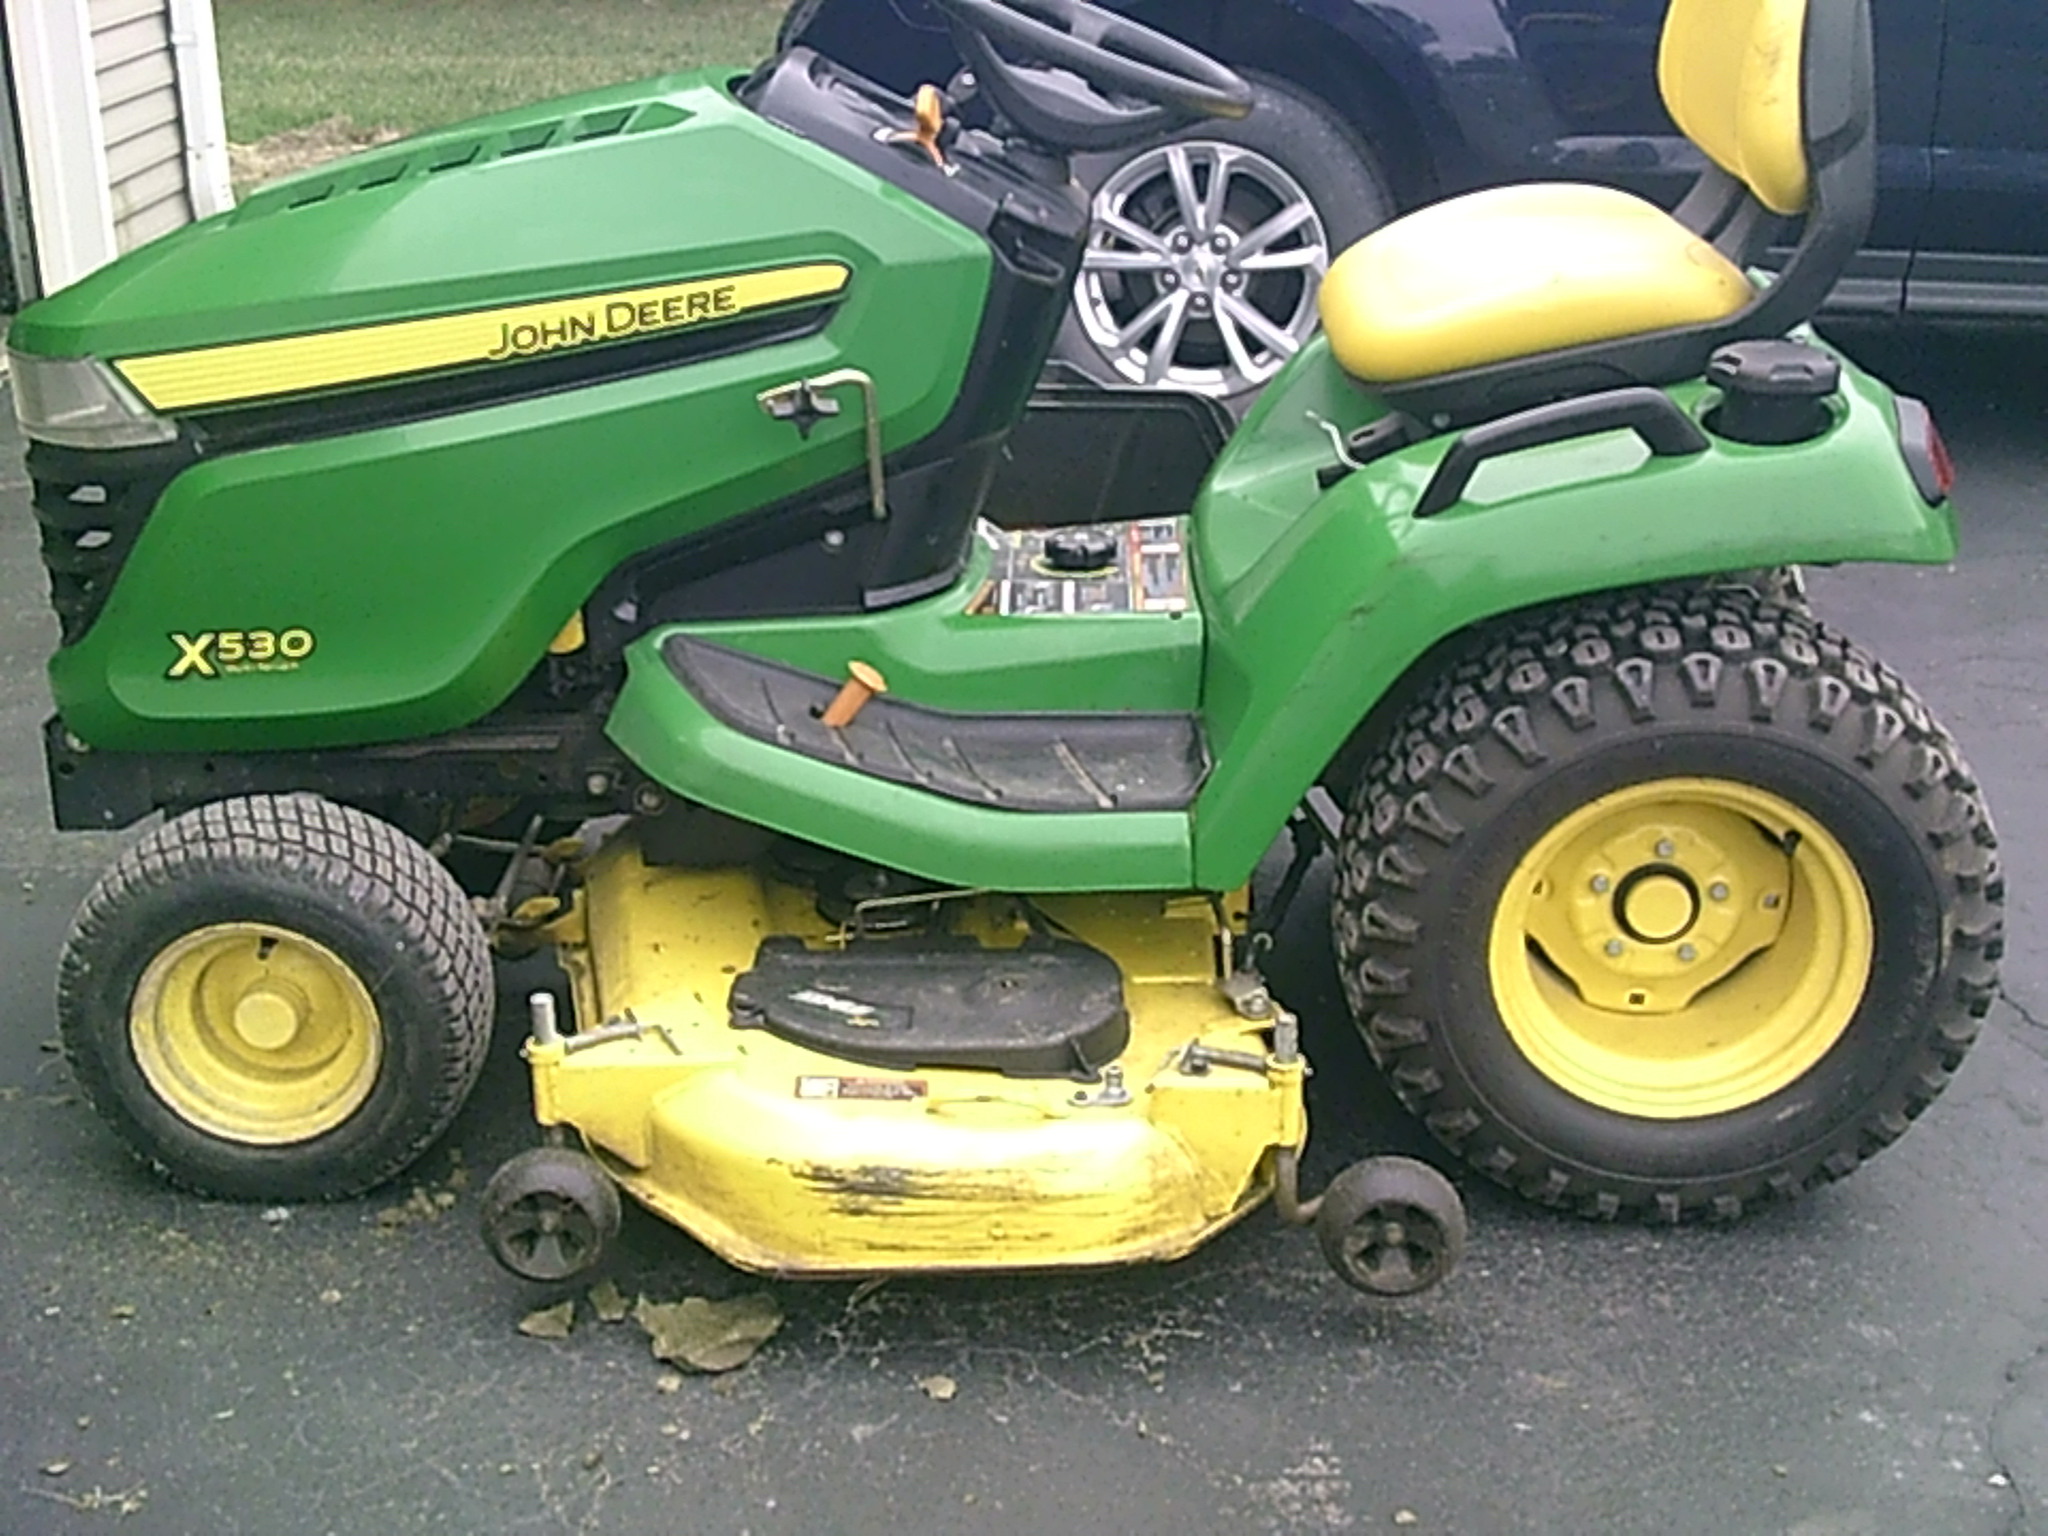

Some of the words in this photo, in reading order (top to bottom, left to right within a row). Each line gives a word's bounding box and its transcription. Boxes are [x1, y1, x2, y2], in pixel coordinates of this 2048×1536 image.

[488, 312, 596, 355] JOHN
[605, 285, 736, 333] DEERE
[167, 628, 315, 678] X530
